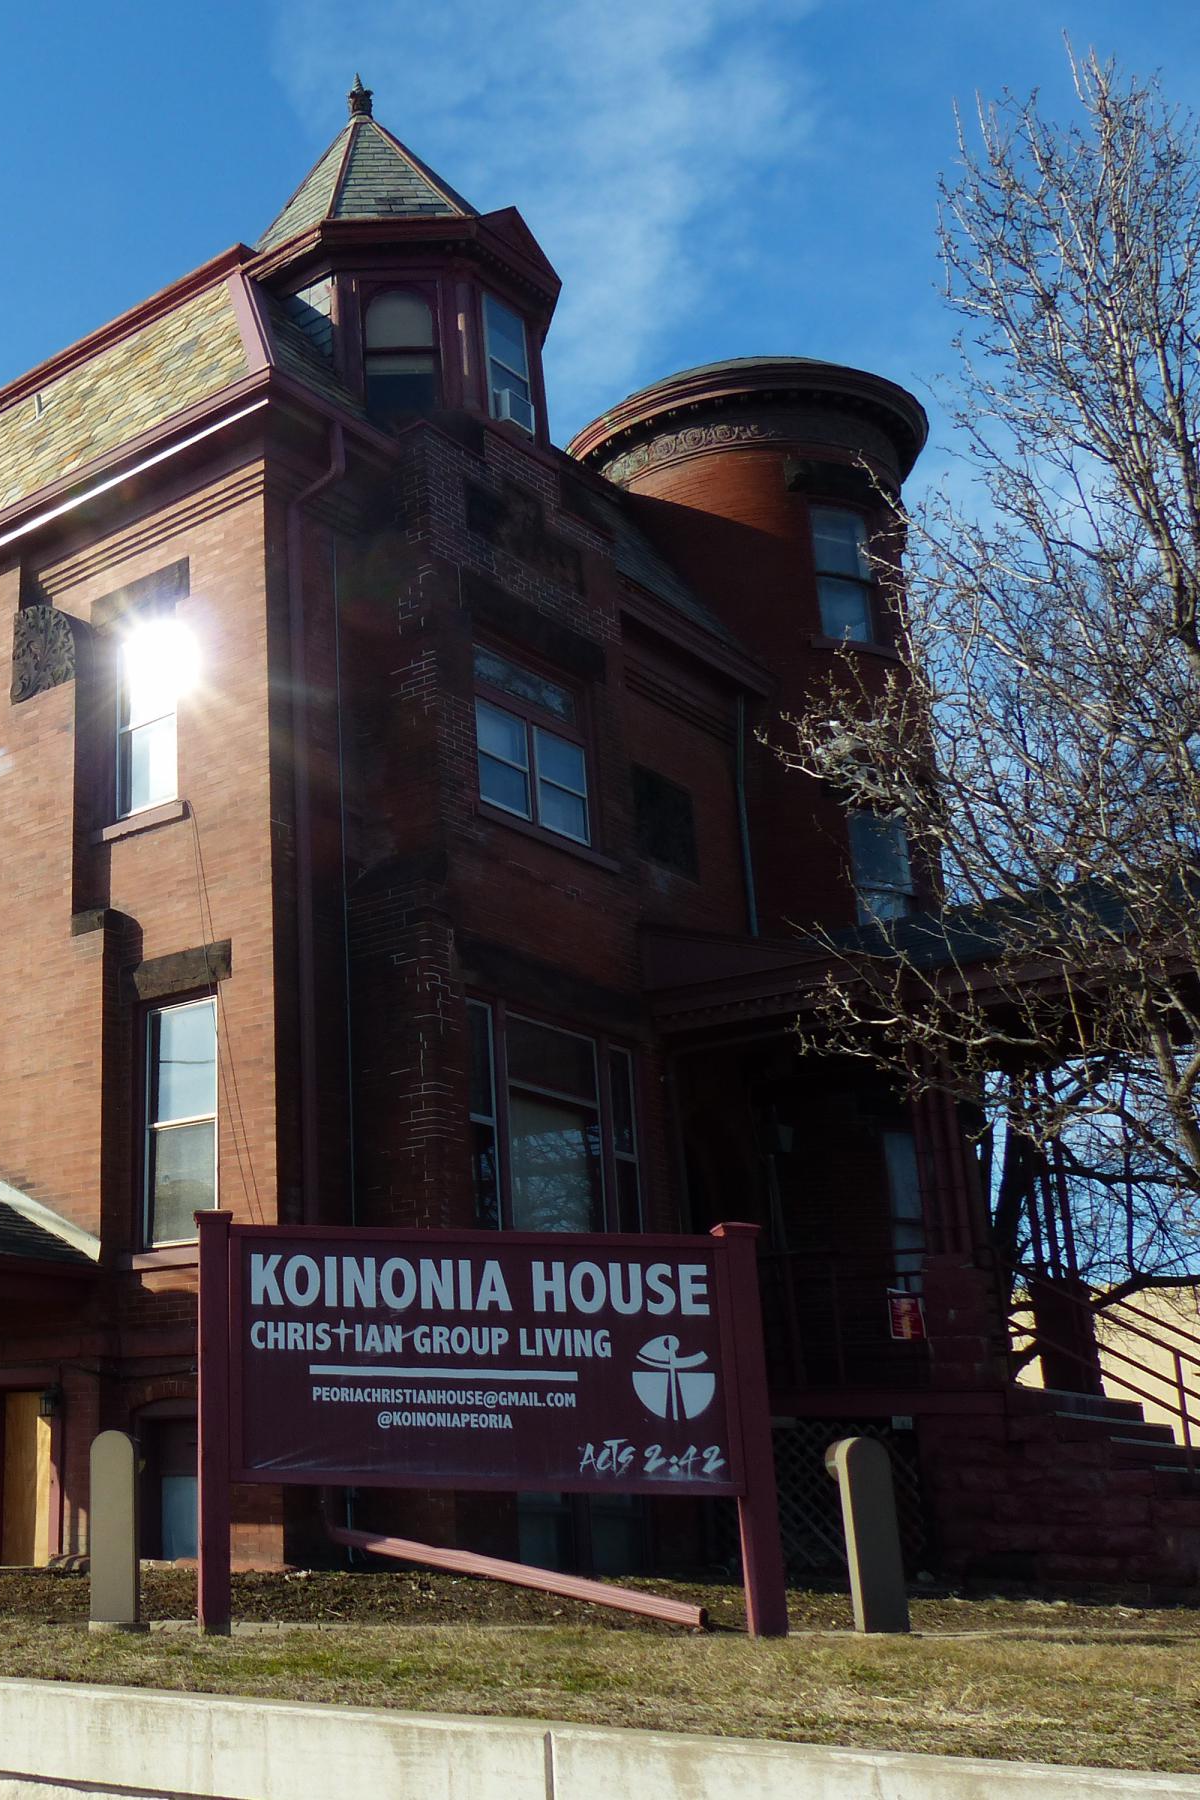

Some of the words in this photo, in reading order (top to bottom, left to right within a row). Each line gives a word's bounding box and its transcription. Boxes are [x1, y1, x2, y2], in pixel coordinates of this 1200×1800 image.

[251, 1253, 513, 1311] KOINONIA
[531, 1261, 710, 1315] HOUSE
[250, 1320, 402, 1354] CHRISTIAN
[413, 1325, 509, 1355] GROUP
[519, 1328, 612, 1358] LIVING
[312, 1386, 576, 1409] PEORIACHRISTIANHOUSE@GMAIL.COM
[377, 1411, 513, 1429] @KOINONIAPEORIA
[643, 1444, 727, 1479] 2:42
